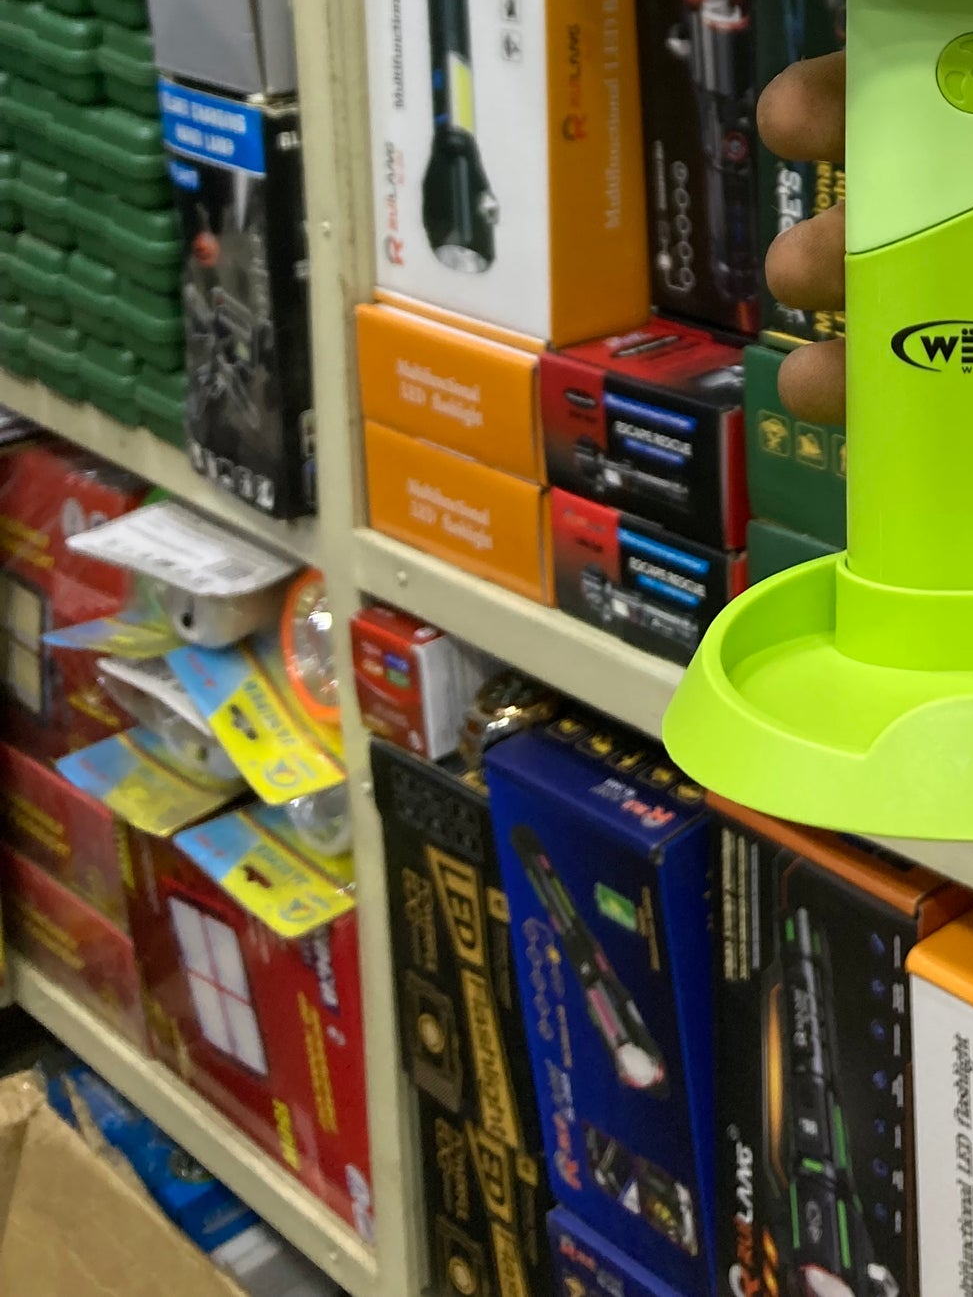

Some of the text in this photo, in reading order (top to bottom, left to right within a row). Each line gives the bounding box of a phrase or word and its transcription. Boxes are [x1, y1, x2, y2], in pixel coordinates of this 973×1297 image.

[776, 169, 804, 233] PE'S
[437, 860, 477, 952] LED
[955, 1132, 973, 1178] LED
